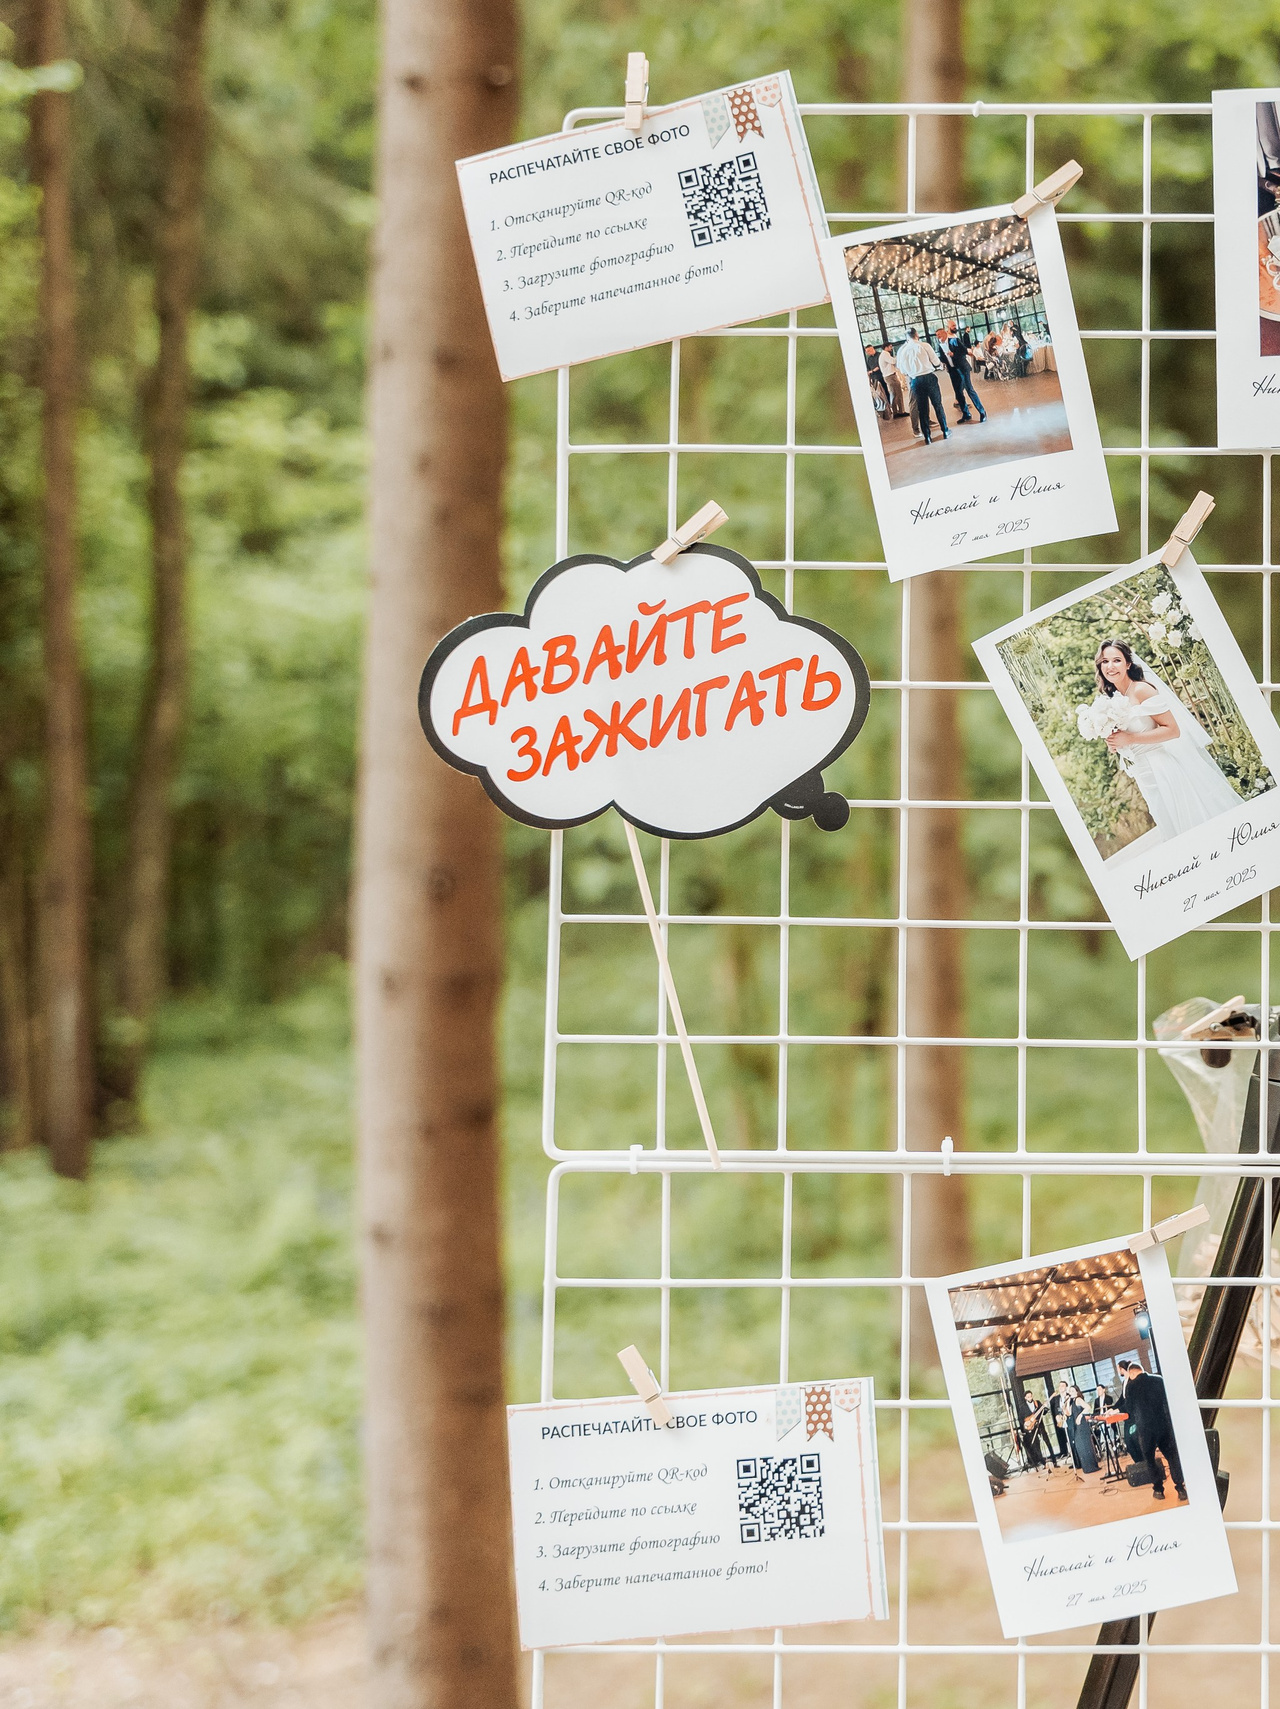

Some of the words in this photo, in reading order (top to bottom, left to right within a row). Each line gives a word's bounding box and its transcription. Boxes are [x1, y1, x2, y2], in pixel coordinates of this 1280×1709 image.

[489, 146, 602, 185] РАСПЕЧАТАЙТЕ
[604, 136, 645, 156] СВОЕ
[647, 124, 690, 146] ФОТО
[490, 219, 500, 232] 1.
[504, 196, 601, 228] Отсканируйте
[604, 181, 653, 207] QR-код
[496, 249, 507, 262] 2.
[510, 233, 582, 259] Перейдите
[585, 229, 601, 240] по
[604, 217, 648, 236] ссылке
[502, 279, 515, 292] 3.
[517, 264, 586, 290] Загрузите
[589, 242, 675, 276] фотографию
[509, 310, 522, 322] 4.
[524, 296, 586, 320] Заберите
[590, 273, 681, 303] напечатанное
[684, 259, 724, 285] фото!
[909, 494, 980, 525] Николай
[988, 495, 1001, 504] и
[1009, 475, 1066, 501] Юлия
[950, 531, 968, 547] 27
[971, 533, 989, 542] мая
[995, 517, 1031, 536] 2025
[452, 592, 750, 736] ДАВАЙТЕ
[506, 654, 842, 782] ЗАЖИГАТЬ
[1133, 854, 1202, 900] Николай
[1209, 850, 1221, 861] и
[1226, 821, 1280, 853] Юлия
[1183, 893, 1198, 913] 27
[1203, 890, 1221, 902] мая
[1225, 864, 1257, 891] 2025
[711, 1410, 758, 1426] ФОТО
[533, 1478, 545, 1491] 1.
[549, 1472, 654, 1490] Отсканируйте
[657, 1464, 708, 1485] QR-код
[534, 1511, 546, 1525] 2.
[549, 1506, 627, 1527] Перейдите
[631, 1506, 647, 1517] по
[650, 1502, 698, 1516] ссылке
[536, 1545, 548, 1559] 3.
[552, 1542, 626, 1560] Загрузите
[628, 1530, 721, 1556] фотографию
[1023, 1554, 1094, 1582] Николай
[1104, 1555, 1116, 1564] и
[1126, 1533, 1182, 1562] Юлия
[538, 1579, 550, 1592] 4.
[554, 1574, 621, 1593] Заберите
[625, 1567, 723, 1585] напечатанное
[725, 1560, 769, 1581] фото!
[1065, 1592, 1084, 1608] 27
[1087, 1595, 1106, 1603] мая
[1112, 1579, 1148, 1599] 2025
